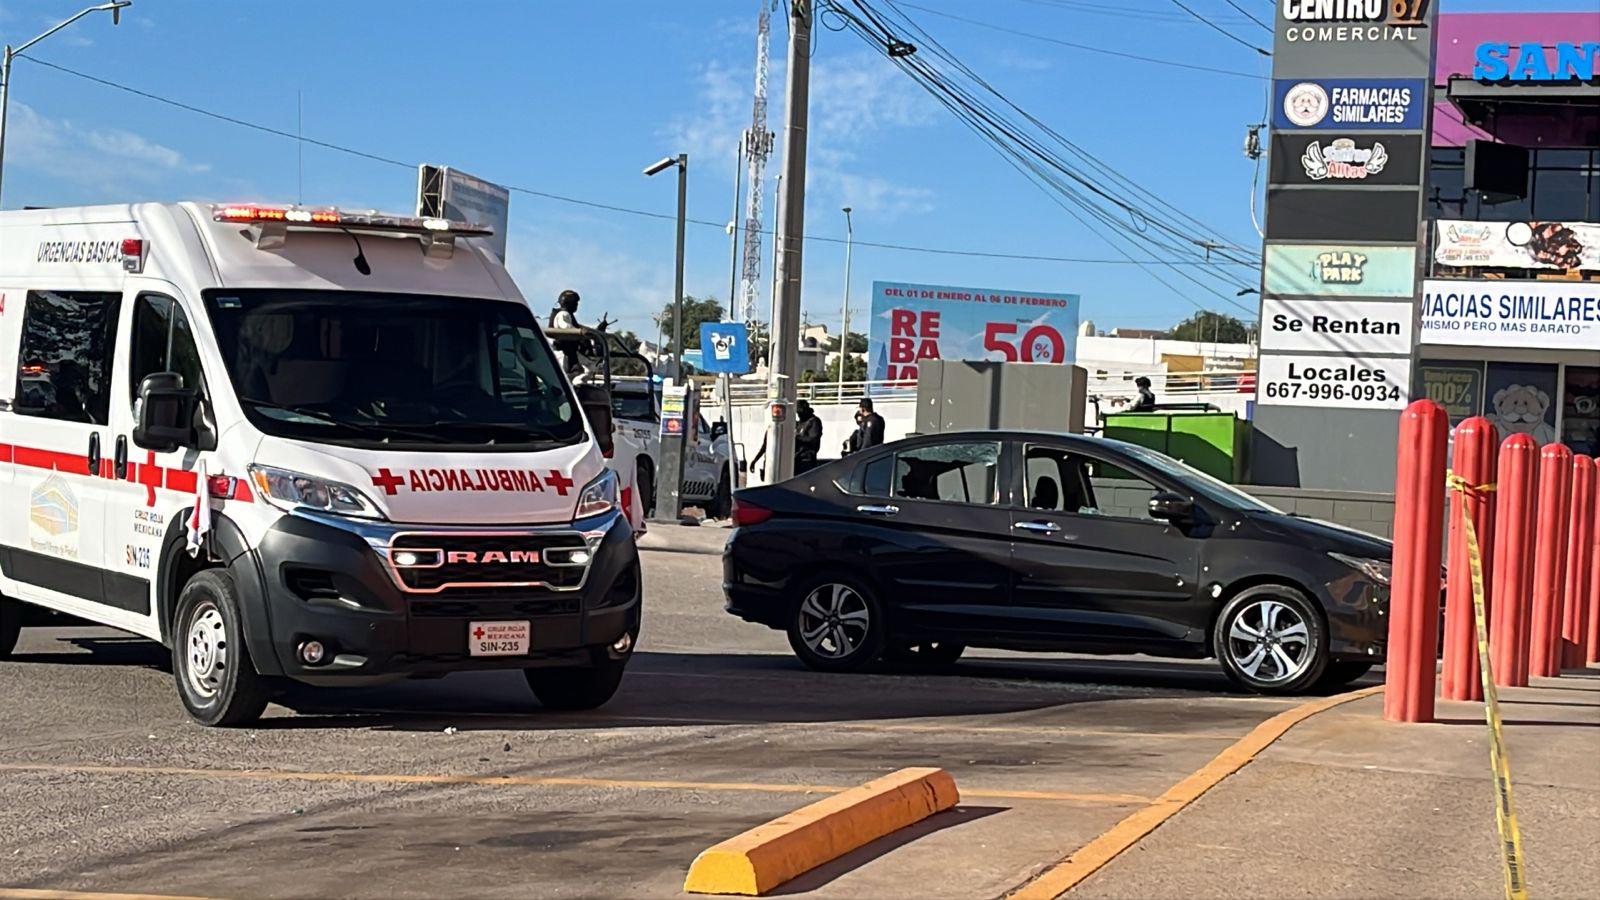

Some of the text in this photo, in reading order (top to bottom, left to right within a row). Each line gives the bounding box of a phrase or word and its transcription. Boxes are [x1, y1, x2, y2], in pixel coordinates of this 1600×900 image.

[1286, 27, 1417, 41] COMERCIAL
[1473, 41, 1600, 80] SAN
[1332, 88, 1411, 105] FARMACIAS
[1333, 105, 1405, 123] SIMILARES
[37, 241, 86, 263] URGENCIAS
[1319, 251, 1367, 268] PLAY
[1322, 267, 1362, 283] PARK
[885, 288, 904, 297] DEL
[906, 290, 918, 298] 01
[921, 291, 935, 299] DE
[937, 291, 972, 301] ENERO
[974, 293, 986, 302] AL
[1004, 296, 1017, 304] DE
[1020, 297, 1068, 308] FEBRERO
[891, 309, 940, 338] RE
[1272, 314, 1400, 335] Se Rentan
[1464, 321, 1497, 331] PERO
[1501, 322, 1527, 333] MAS
[1530, 323, 1581, 335] BARATO
[890, 338, 941, 364] BA
[1288, 363, 1386, 382] Locales
[1266, 382, 1400, 401] 667-996-0934
[134, 523, 162, 537] MEXICANA
[447, 551, 540, 563] RAM
[480, 641, 519, 652] SIN-235
